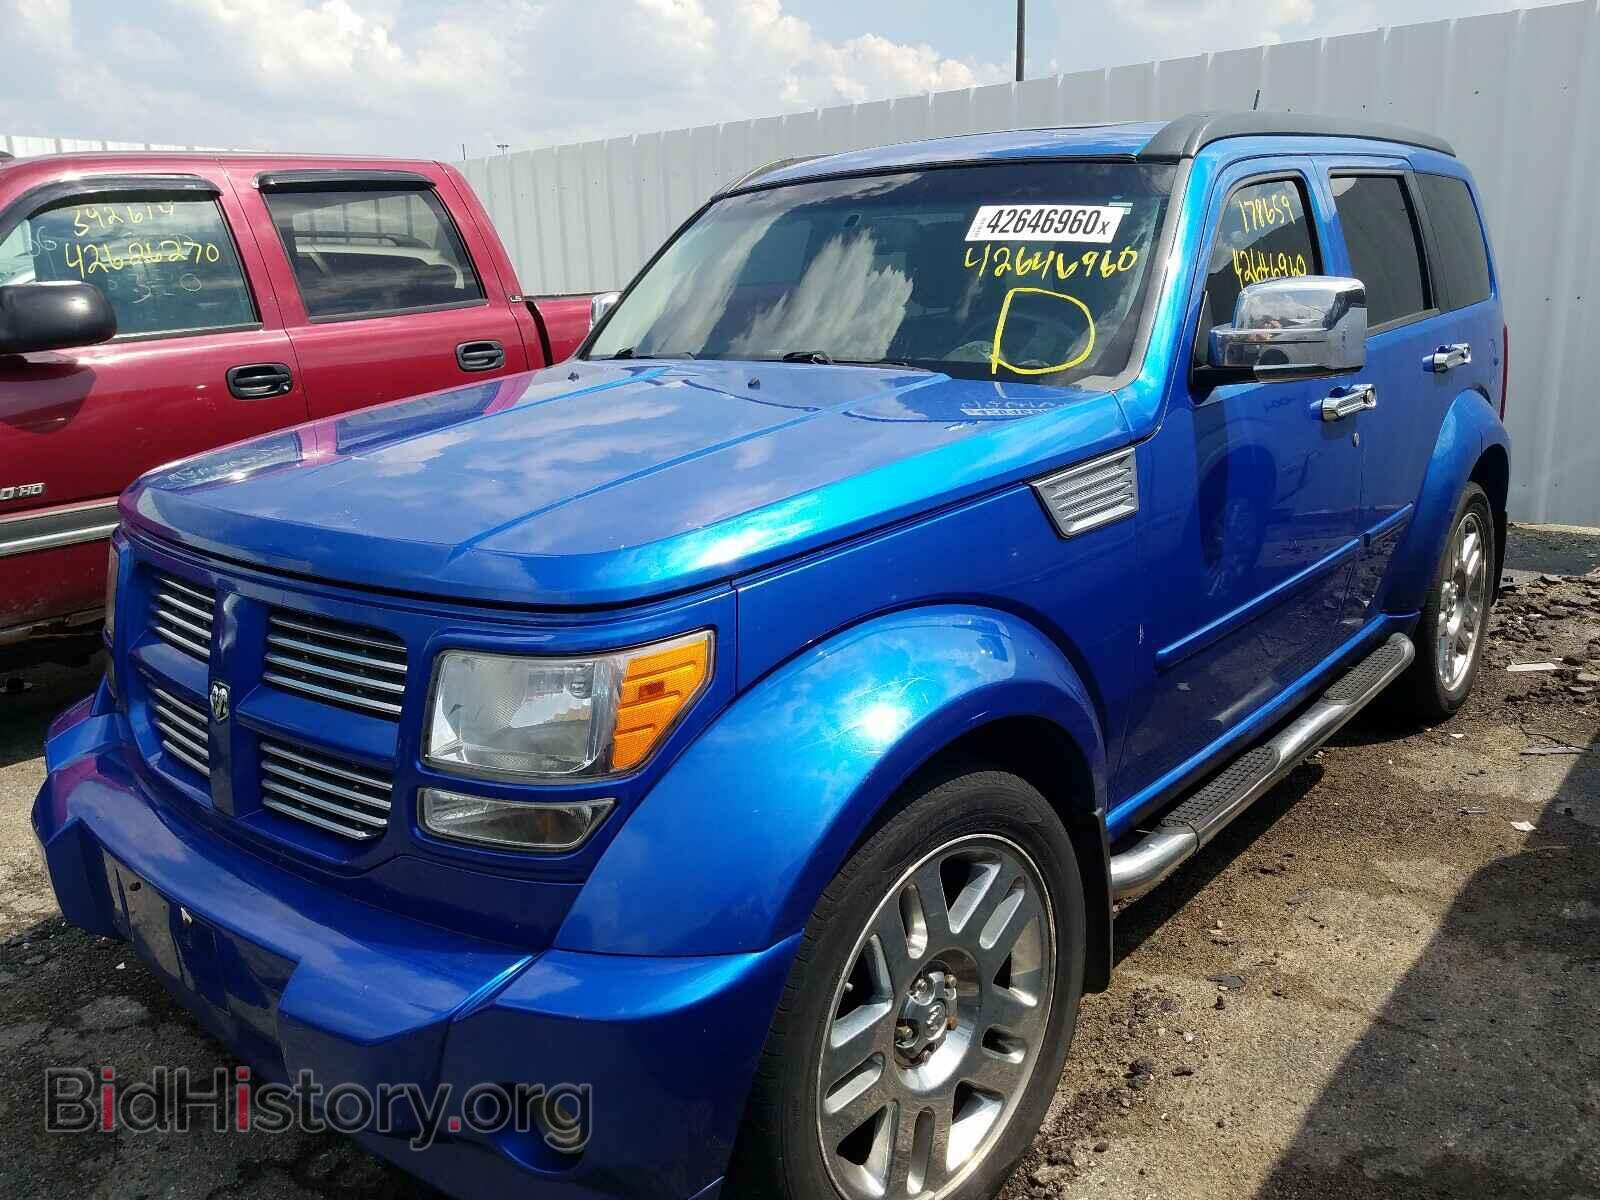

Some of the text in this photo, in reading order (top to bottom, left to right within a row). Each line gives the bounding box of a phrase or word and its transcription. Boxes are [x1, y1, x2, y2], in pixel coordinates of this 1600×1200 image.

[1238, 193, 1296, 234] 178659
[963, 244, 1138, 281] 42646960
[991, 287, 1096, 375] D
